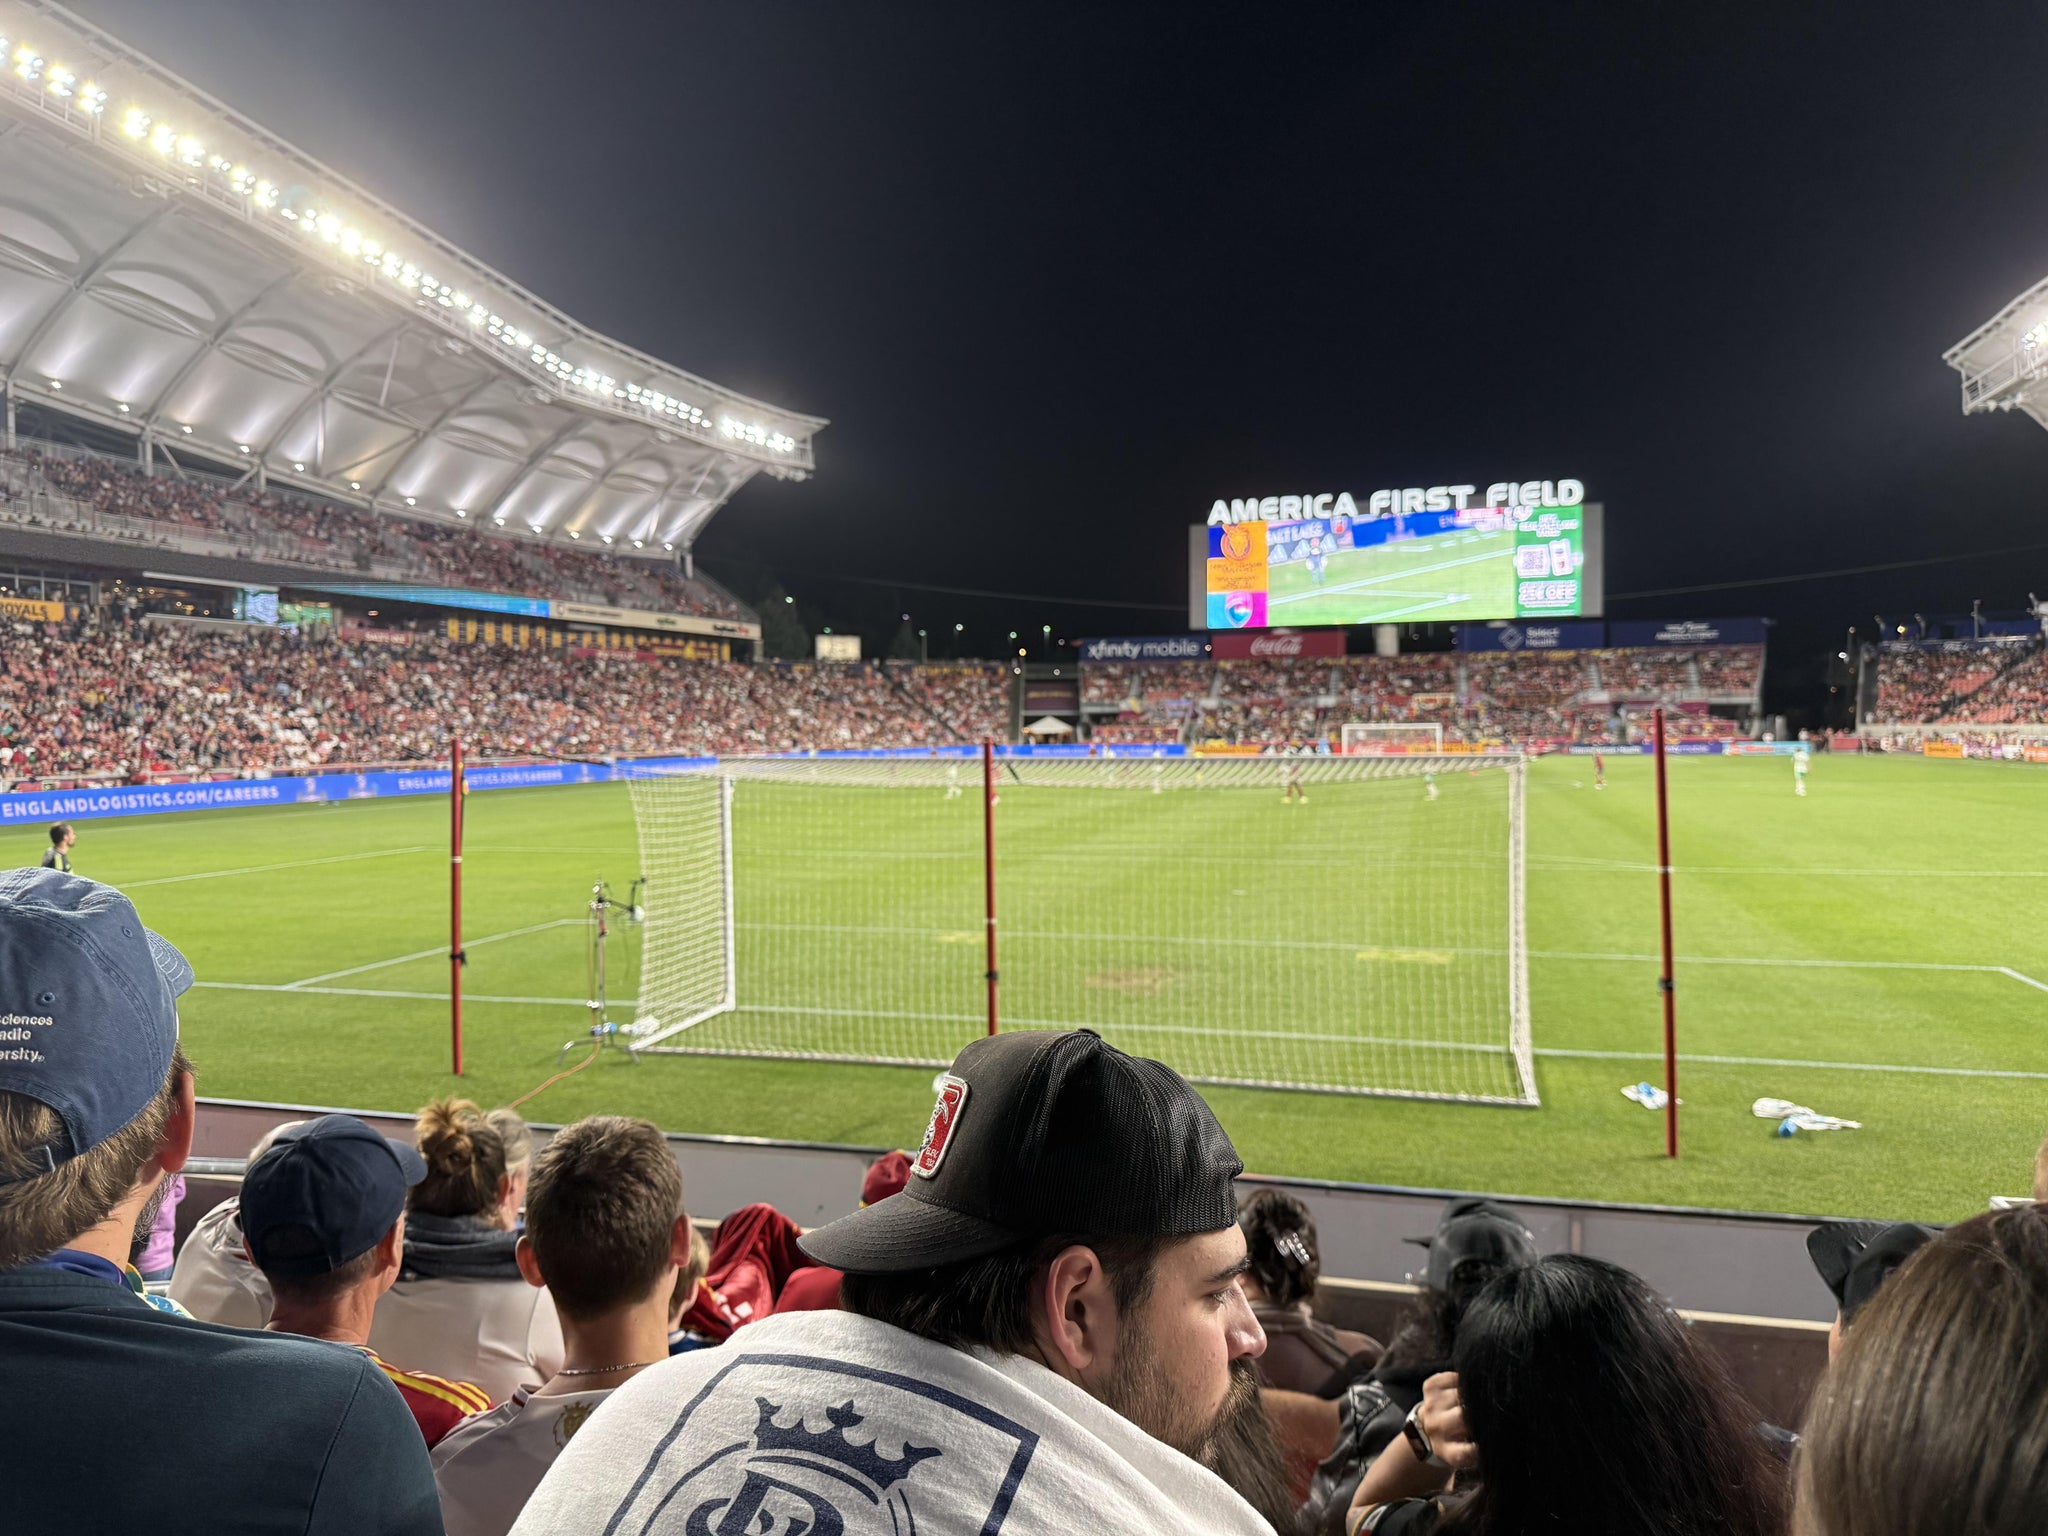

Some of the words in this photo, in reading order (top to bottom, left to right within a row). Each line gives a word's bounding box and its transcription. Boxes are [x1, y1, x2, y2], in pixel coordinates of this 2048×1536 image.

[1207, 491, 1359, 526] AMERICA
[1369, 484, 1476, 517] FIRST
[1486, 479, 1584, 509] FIELD
[1526, 627, 1560, 638] Select
[1088, 639, 1141, 660] xfinity
[1143, 637, 1200, 656] mobile
[1526, 638, 1558, 648] Health
[2, 785, 279, 818] ENGLANDLOGISTICS.COM/CAREERS
[0, 1013, 53, 1025] ciences
